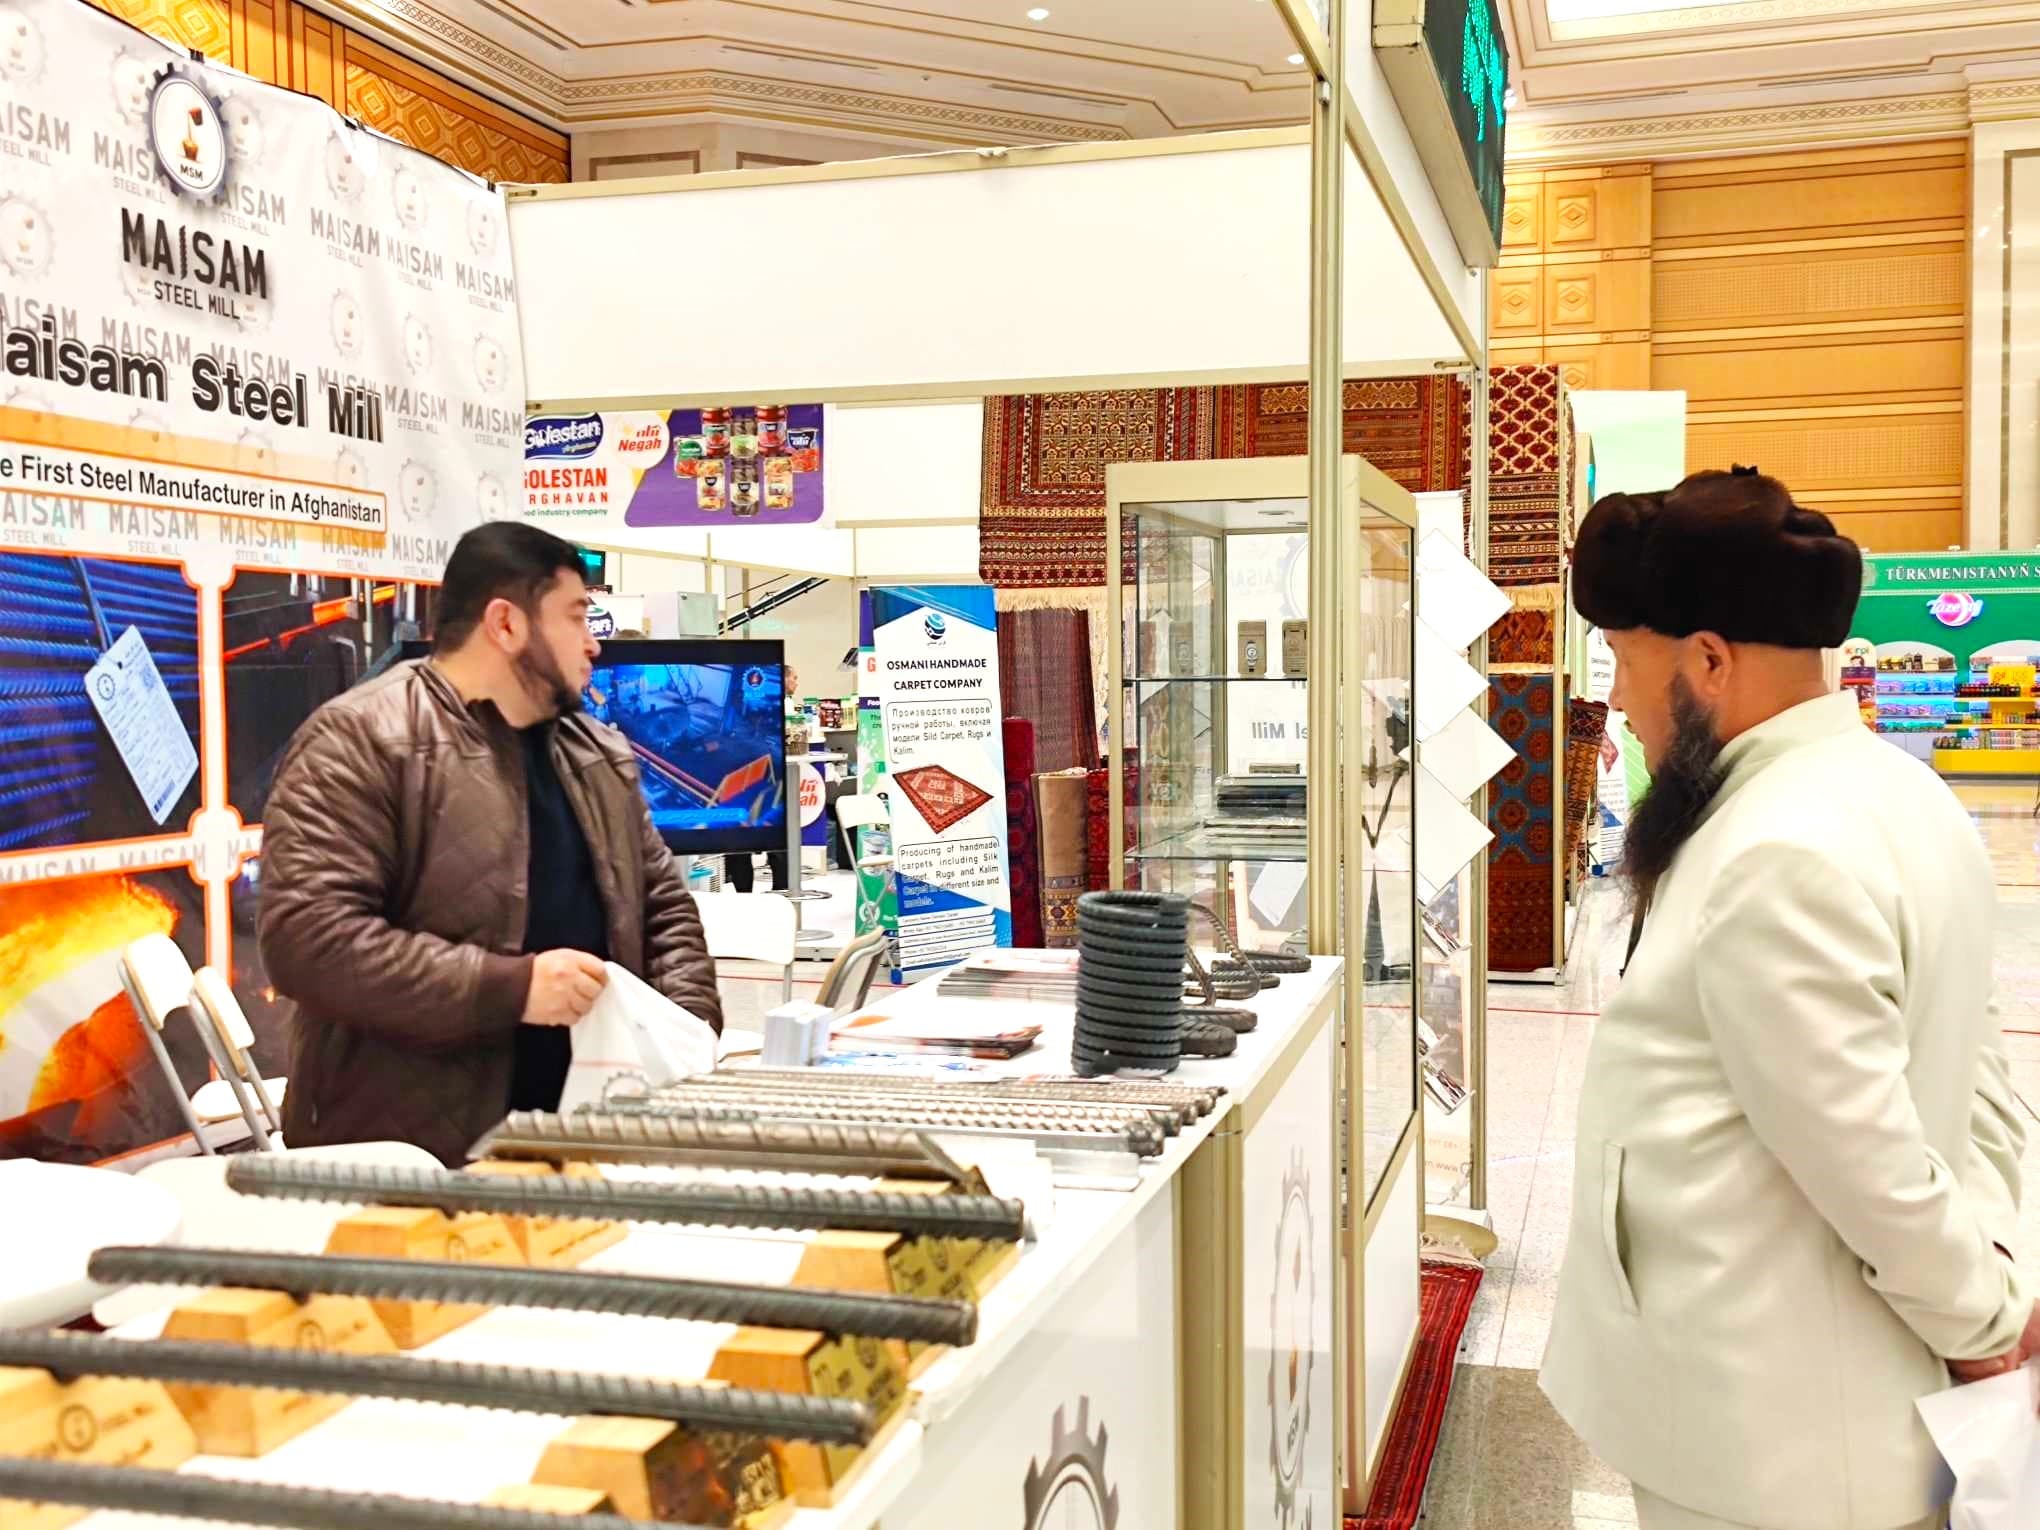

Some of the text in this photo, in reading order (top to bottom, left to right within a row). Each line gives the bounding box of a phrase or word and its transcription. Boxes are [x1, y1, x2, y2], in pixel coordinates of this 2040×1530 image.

[180, 163, 203, 180] MSM
[310, 207, 380, 257] MAISAM
[121, 207, 267, 299] MAISAM
[386, 234, 444, 281] MAISAM
[455, 261, 515, 303] MAISAM
[154, 280, 240, 320] STEEL MILL
[0, 314, 385, 444] aisam Steel Mill
[385, 384, 448, 422] MAISAM
[462, 401, 522, 438] MAISAM
[618, 439, 662, 451] Negah
[21, 455, 73, 485] First
[80, 462, 133, 492] Steel
[139, 471, 265, 509] Manufacturer
[270, 489, 286, 511] in
[291, 492, 382, 523] Afghanistan
[109, 504, 200, 541] MAISAM
[220, 515, 296, 550] MAISAM
[322, 527, 383, 560] MAISAM
[392, 533, 449, 566] MAISAM
[1886, 562, 2029, 581] TÜRKMENISTANYŇ
[887, 658, 988, 670] OSMANI HANDMADE
[894, 678, 982, 690] CARPET COMPANY
[901, 841, 997, 857] Producing of handmade
[902, 853, 998, 870] carpets including Silk
[936, 870, 955, 880] Rugs
[961, 868, 974, 876] and
[980, 865, 998, 873] Kalim
